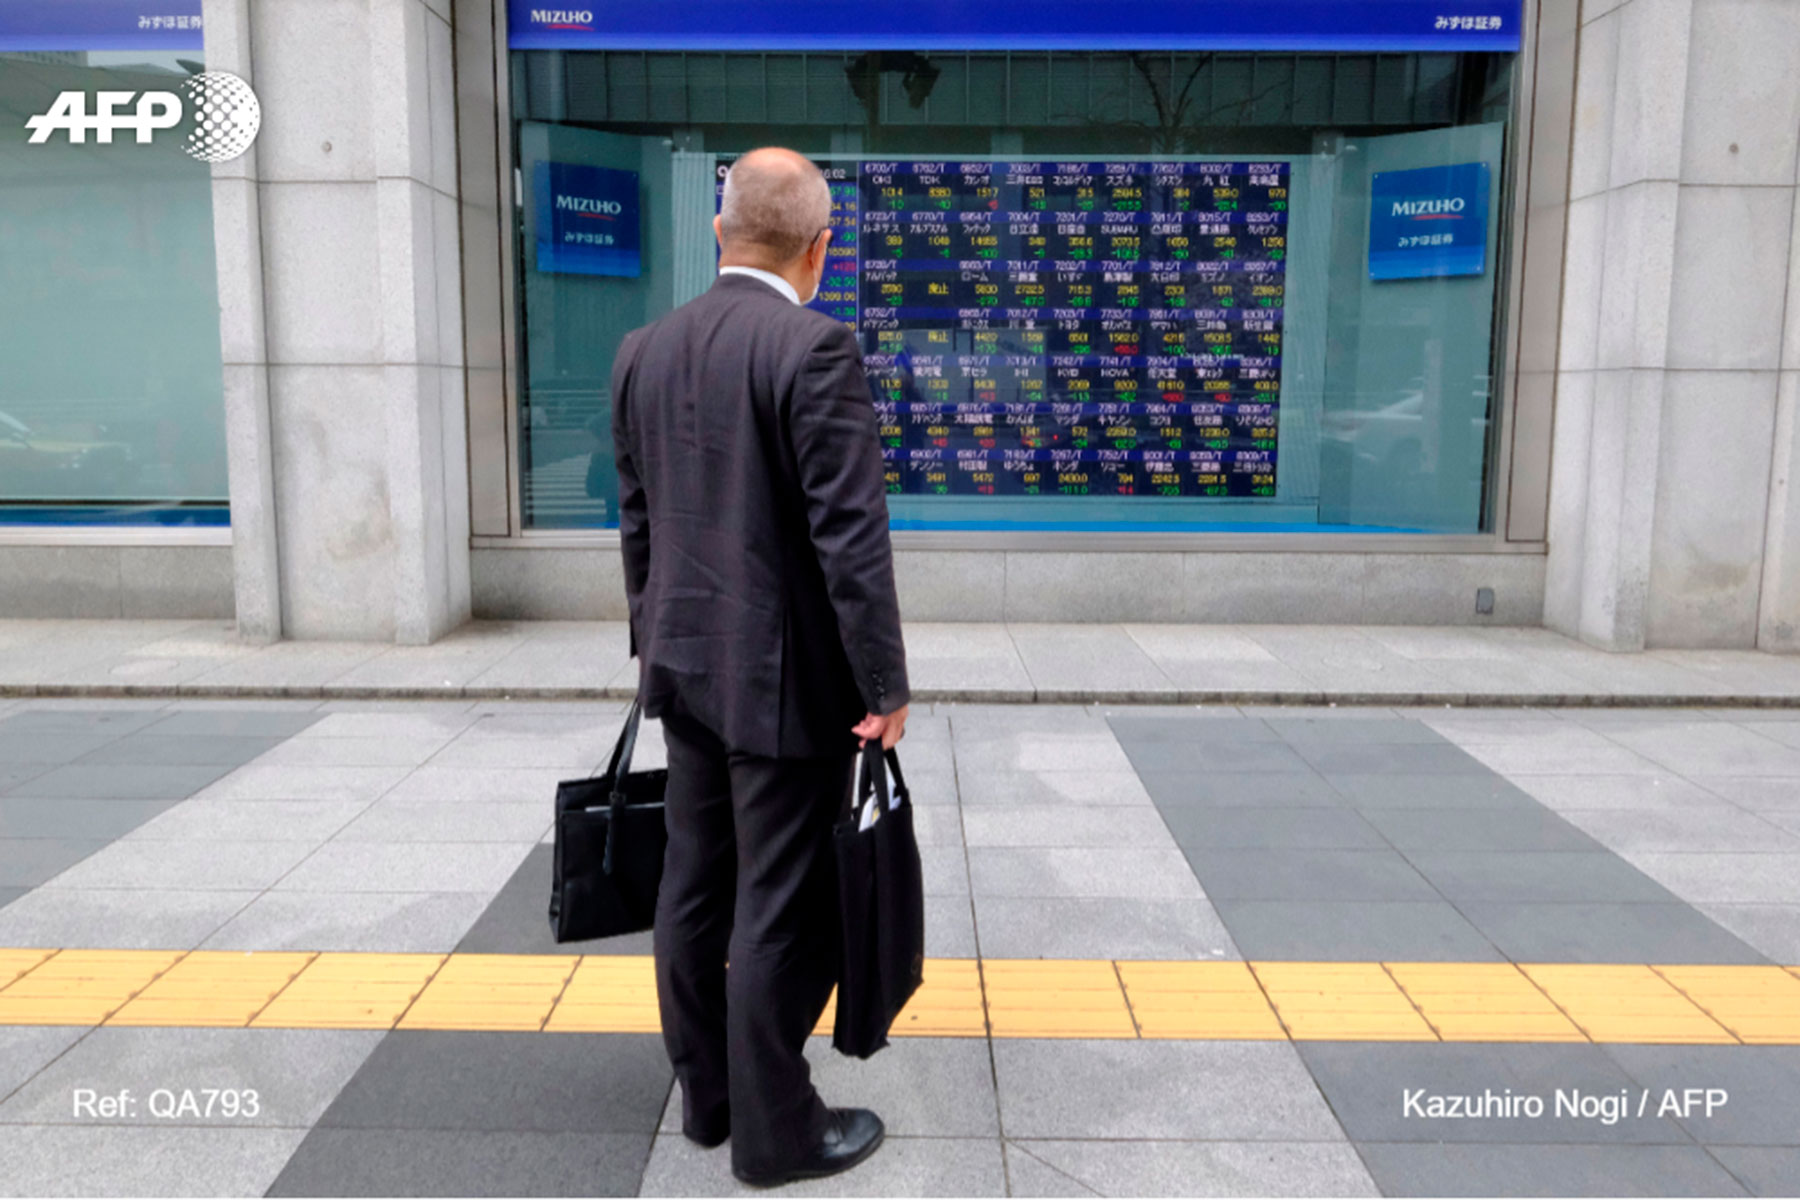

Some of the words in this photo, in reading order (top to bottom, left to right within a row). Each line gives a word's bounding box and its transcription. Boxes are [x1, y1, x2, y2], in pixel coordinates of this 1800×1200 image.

[530, 9, 593, 25] MIZUHO
[1434, 16, 1502, 30] みずほ証券
[556, 194, 622, 216] MIZUHO
[1391, 197, 1465, 217] MIZUHO
[1397, 232, 1453, 247] みずほ証券
